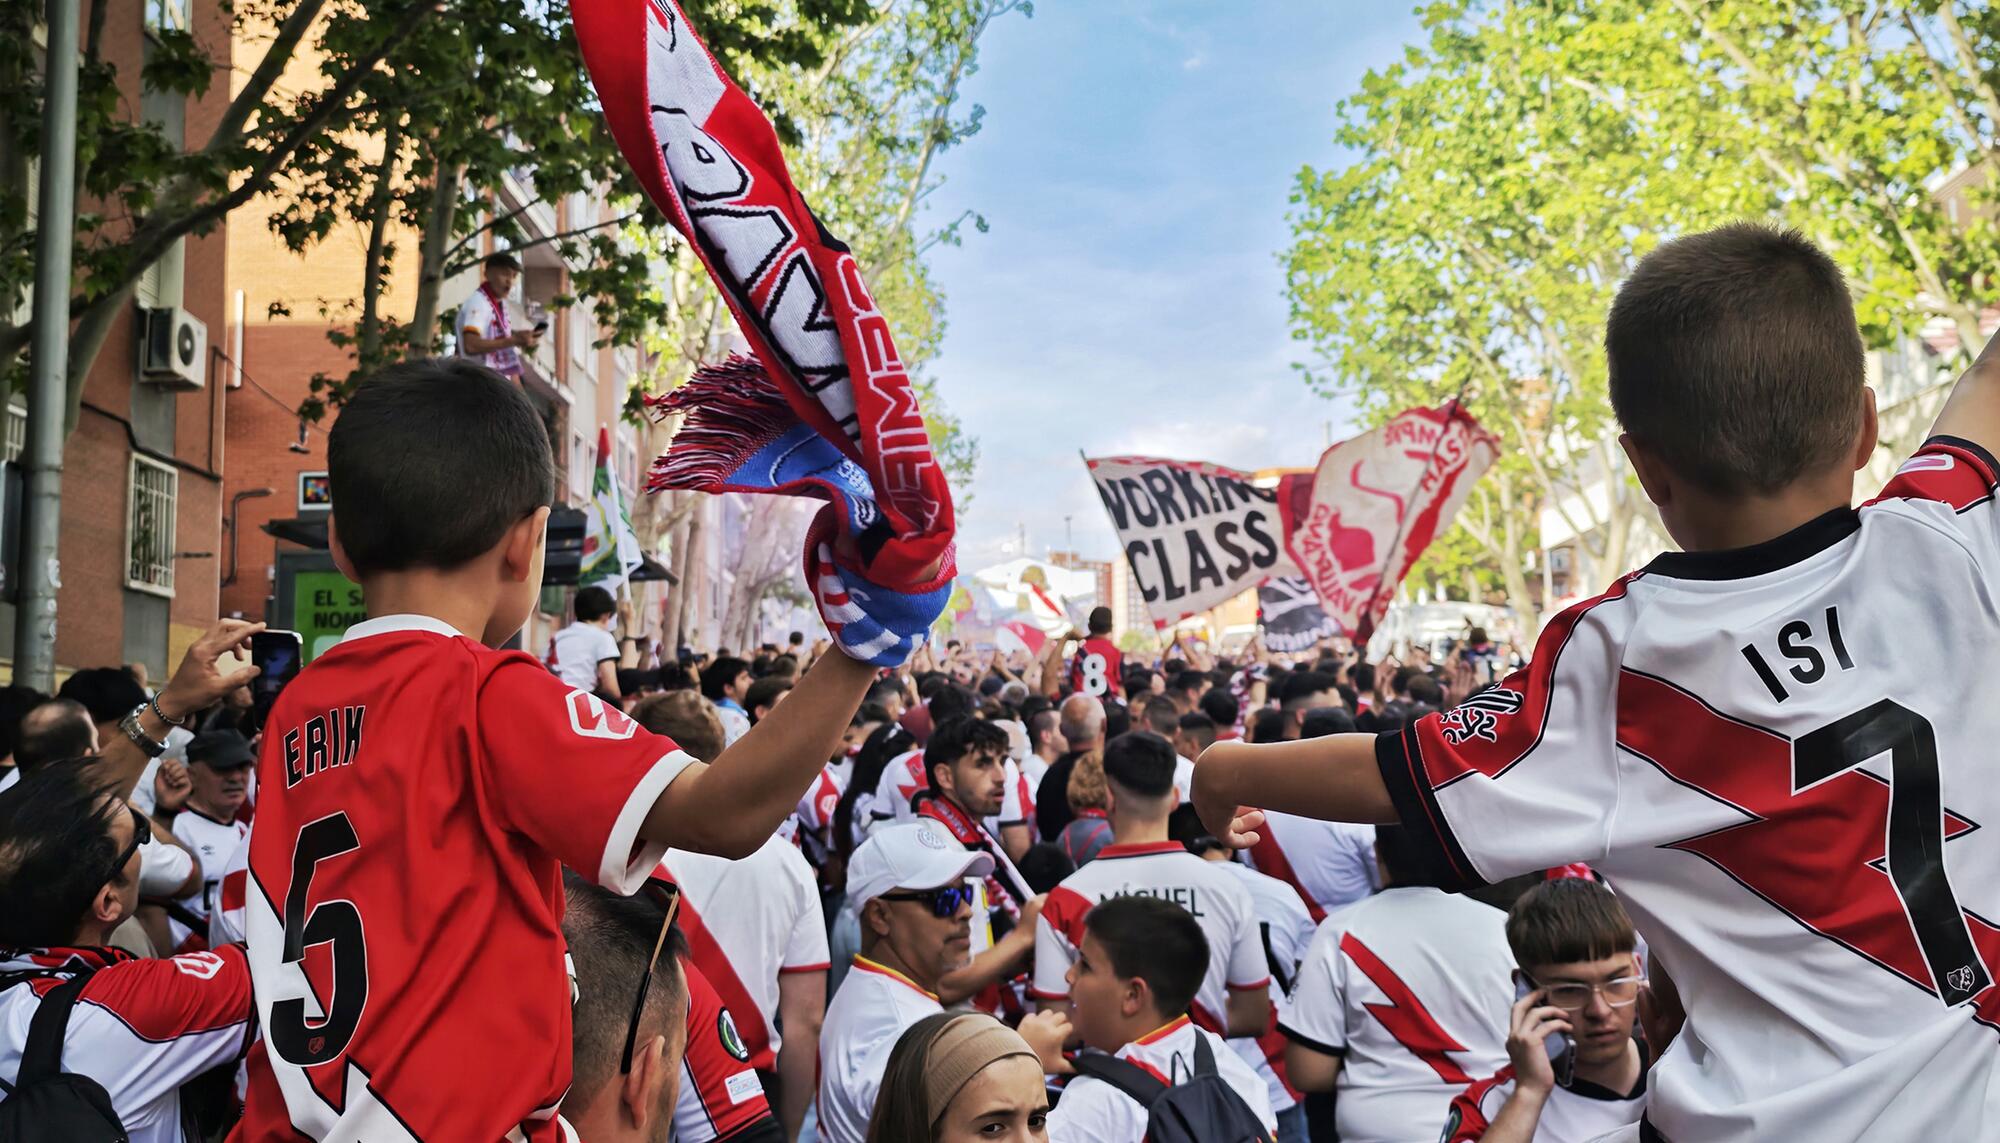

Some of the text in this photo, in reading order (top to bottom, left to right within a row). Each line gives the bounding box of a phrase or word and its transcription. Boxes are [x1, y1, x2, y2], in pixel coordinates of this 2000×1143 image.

[314, 589, 365, 607] EL S
[1126, 510, 1278, 602] CLASS
[1082, 653, 1107, 698] 8
[1739, 603, 1856, 704] ISI
[283, 705, 366, 790] ERIK
[1791, 697, 1995, 1007] 7
[270, 809, 368, 1068] 5
